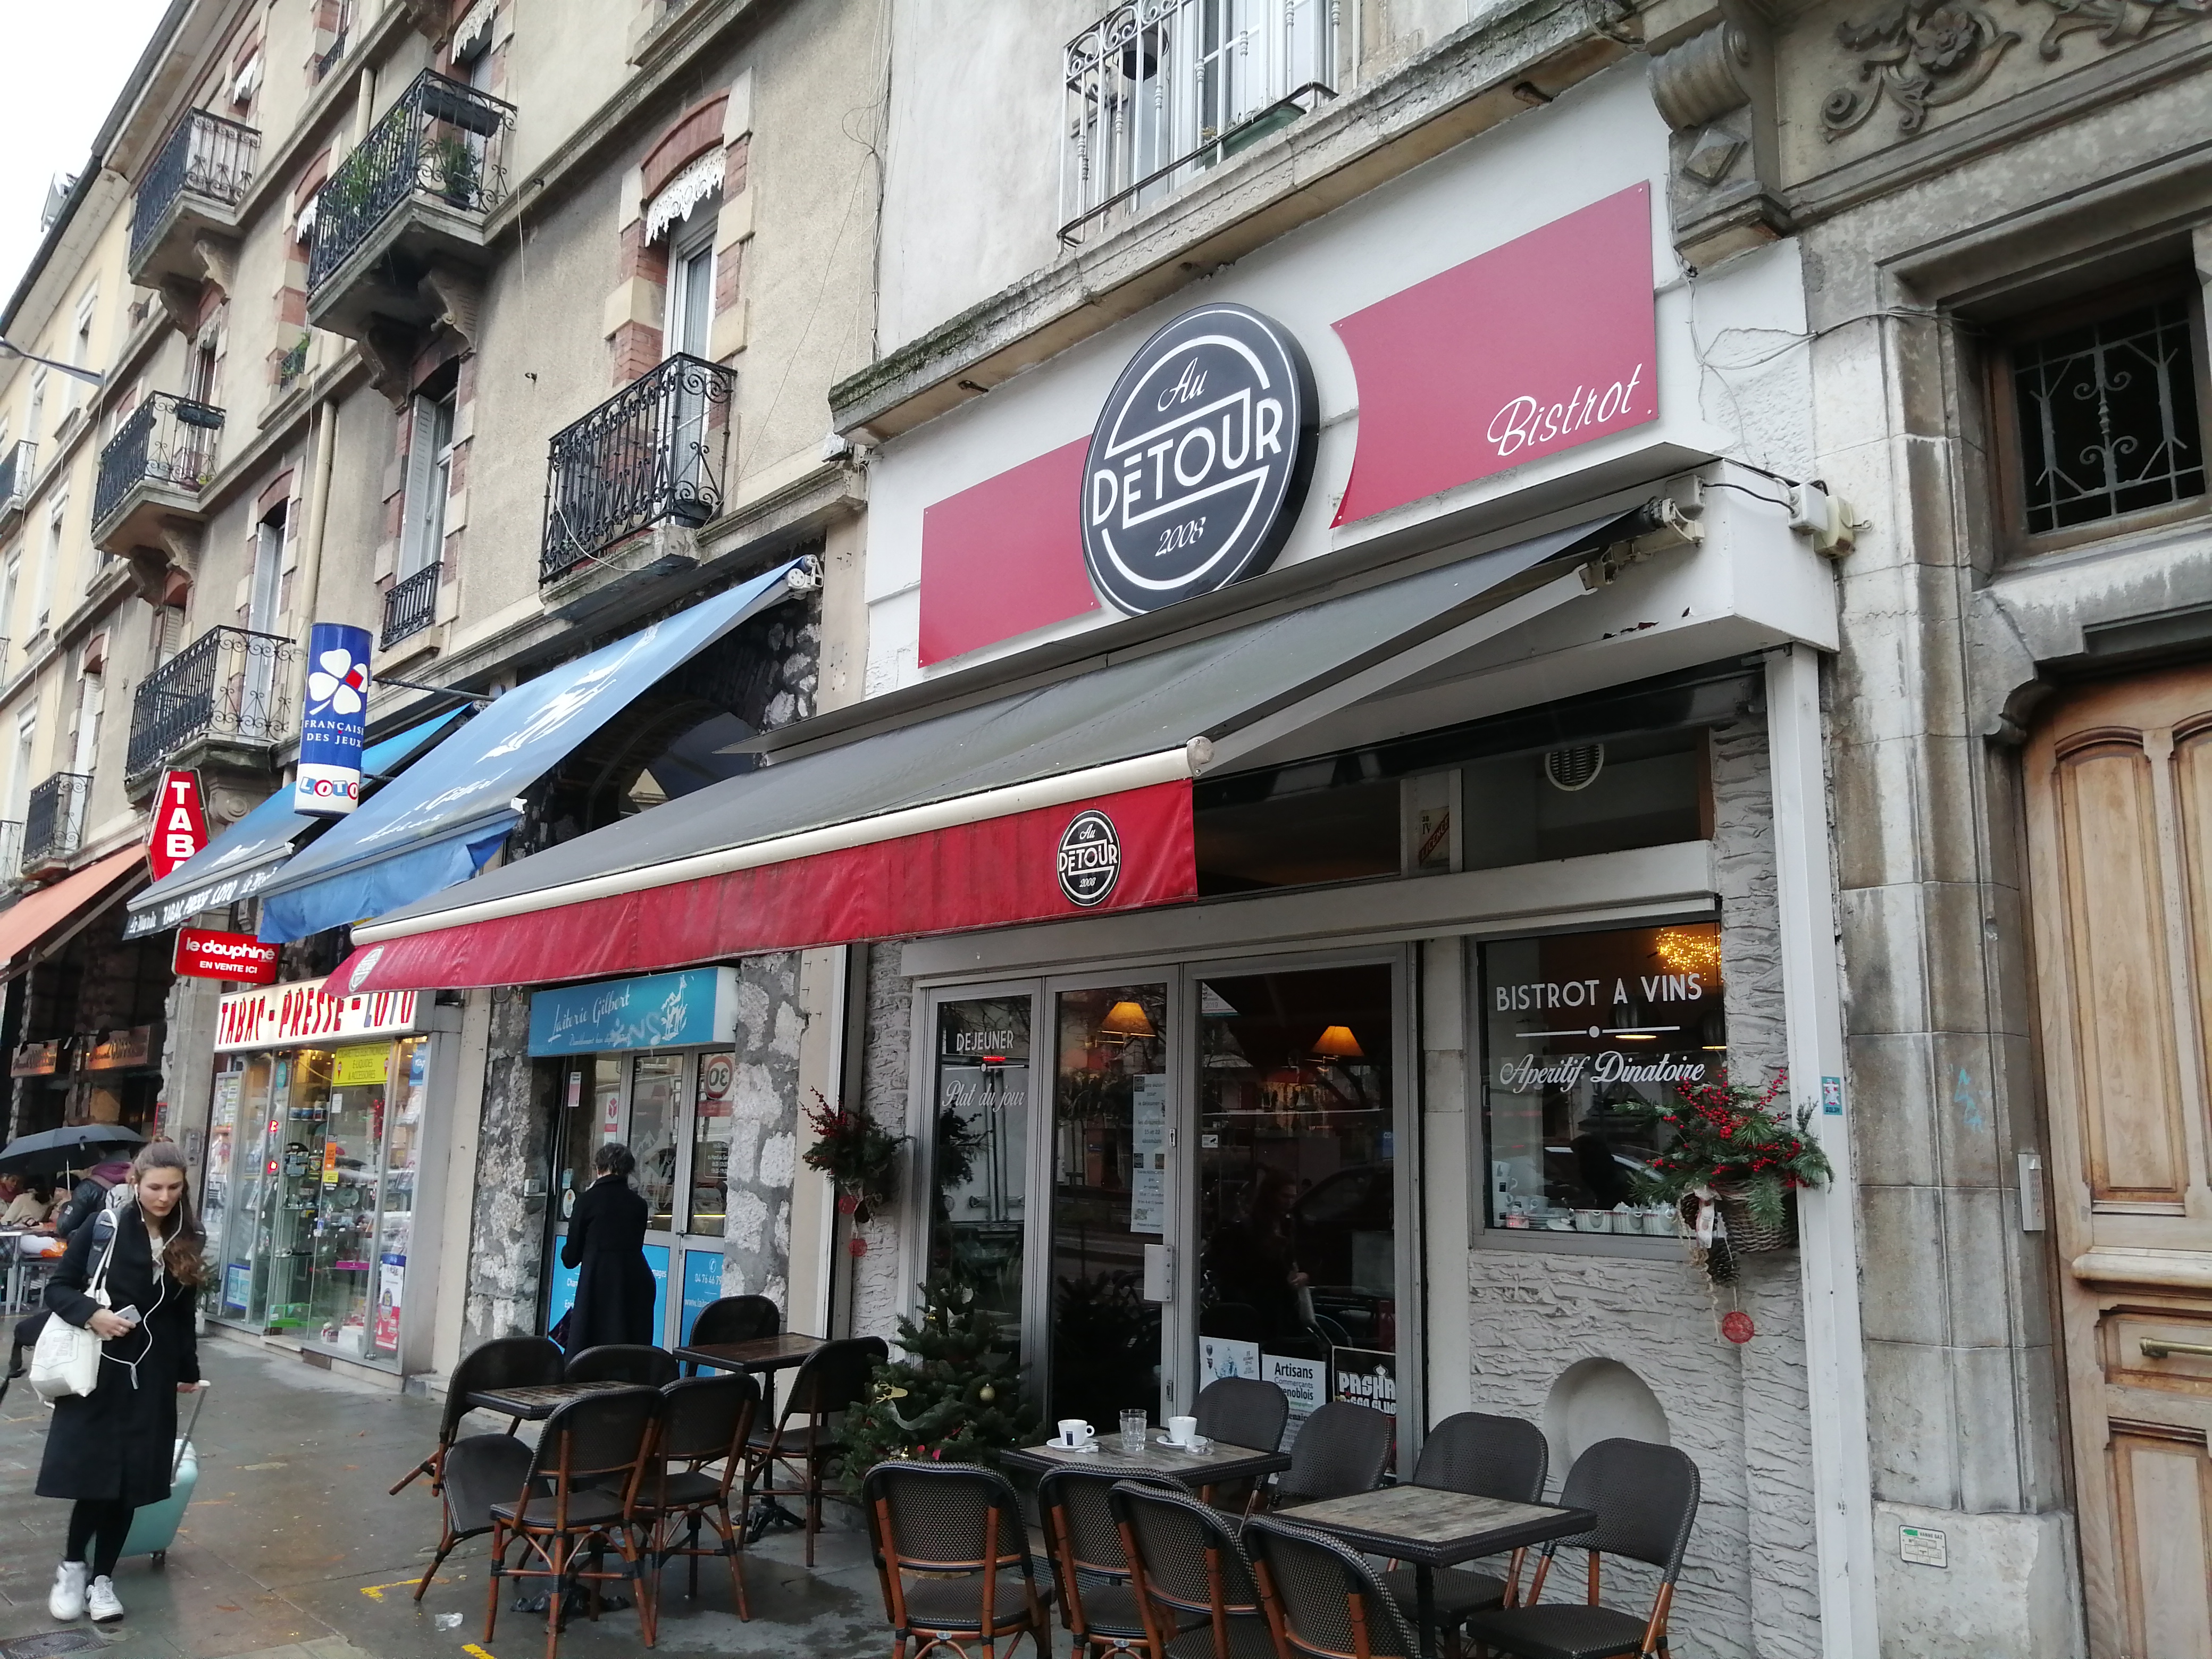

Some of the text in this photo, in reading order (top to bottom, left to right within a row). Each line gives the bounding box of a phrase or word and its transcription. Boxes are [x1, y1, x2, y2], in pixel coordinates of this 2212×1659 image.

[1157, 357, 1208, 412] Au
[1487, 363, 1643, 456] Bistrot
[1092, 396, 1284, 529] DETOUR
[1155, 517, 1206, 557] 2008
[307, 733, 362, 748] DES JEUX
[299, 776, 359, 800] LOTO
[1079, 824, 1096, 840] Au
[1059, 843, 1118, 873] DETOUR
[1079, 877, 1096, 887] 2008
[163, 899, 185, 925] TABAC
[210, 879, 238, 905] LOTO
[186, 937, 200, 952] le
[199, 960, 258, 974] EN VENTE ICI
[1496, 973, 1702, 1012] BISTROT A VINS
[218, 995, 266, 1045] TABAC
[279, 987, 345, 1038] PRESSE
[548, 1004, 588, 1045] Laiterie
[593, 984, 631, 1028] Gilbert
[956, 1030, 1014, 1052] DEJEUNER
[1499, 1050, 1705, 1094] Aperitif Dinatoire
[942, 1080, 1026, 1112] Plat du jour
[694, 1273, 701, 1283] 04
[701, 1274, 708, 1284] 76
[1274, 1362, 1313, 1379] Artisans
[1274, 1377, 1313, 1389] Commerçants
[1281, 1387, 1314, 1400] enoblois
[1338, 1371, 1396, 1400] PASHA
